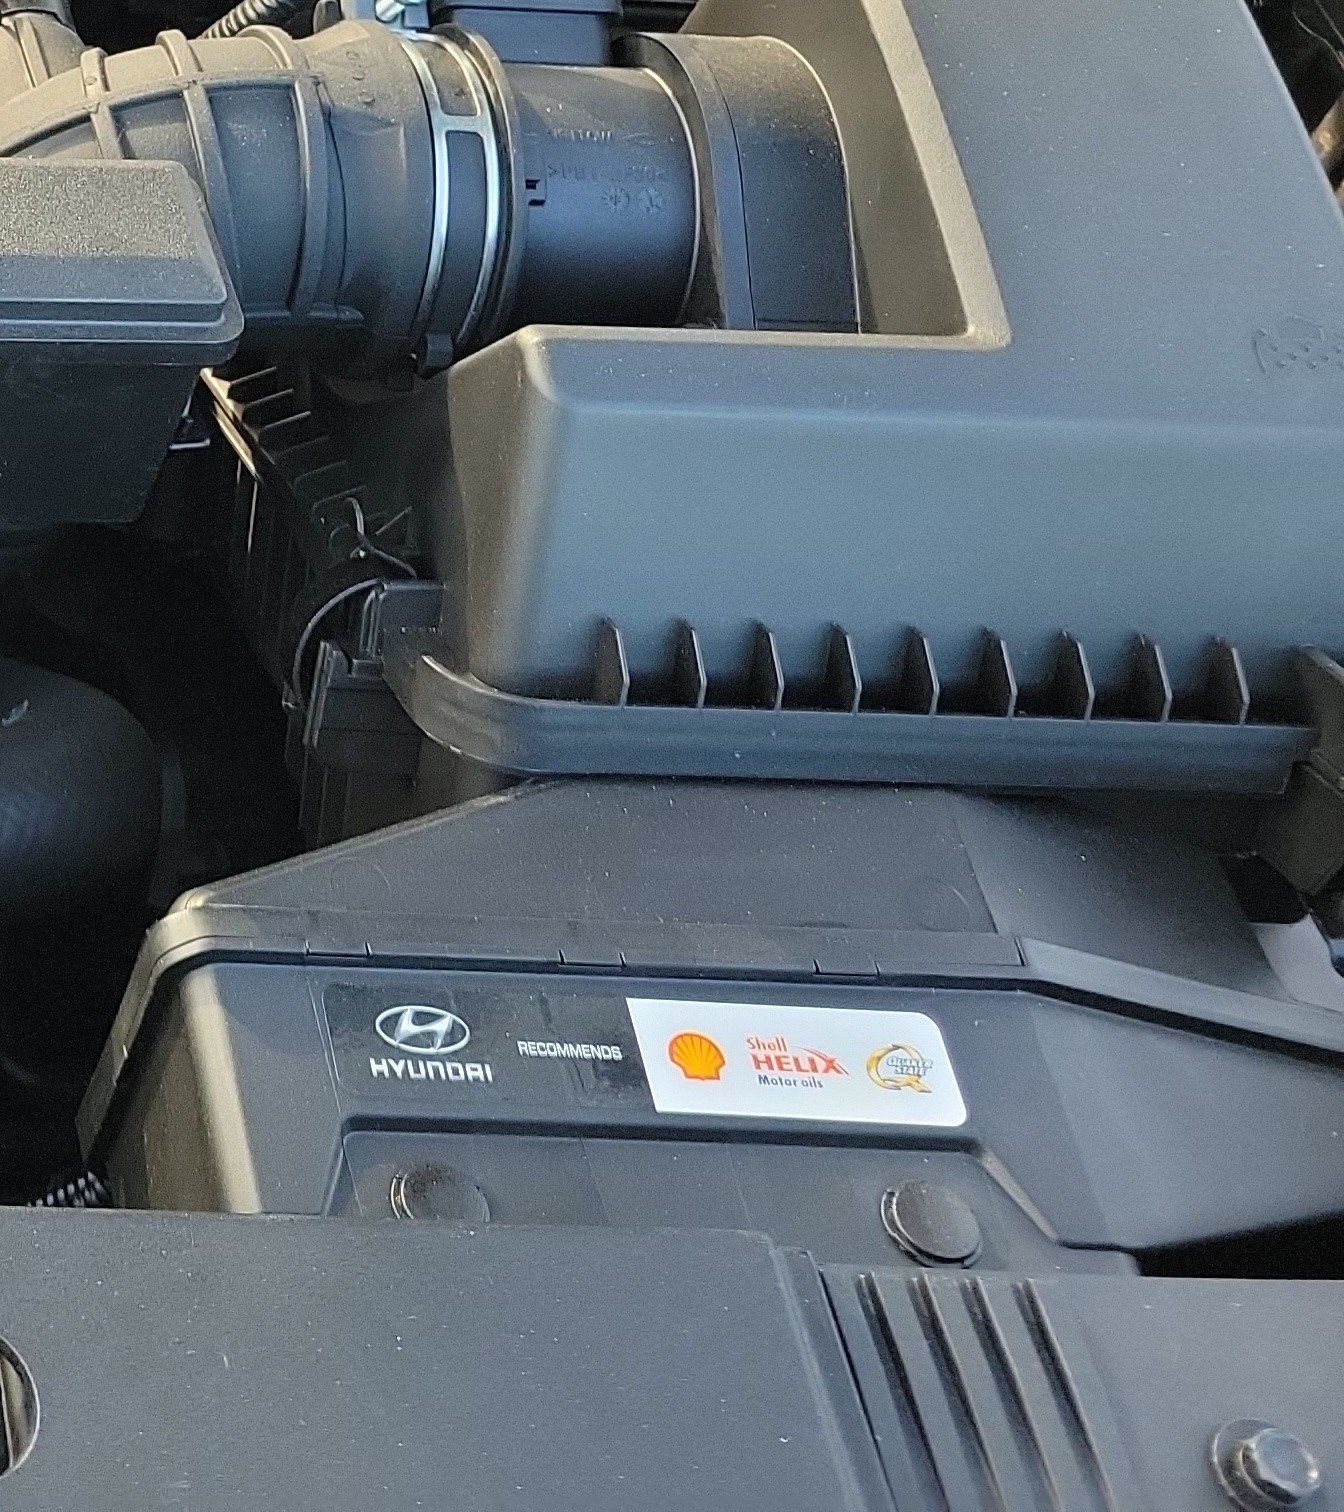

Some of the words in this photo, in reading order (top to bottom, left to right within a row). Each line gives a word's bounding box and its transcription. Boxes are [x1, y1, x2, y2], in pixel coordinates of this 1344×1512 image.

[746, 1036, 788, 1052] Shell
[370, 1057, 493, 1083] HYUNDAI
[517, 1040, 623, 1062] RECOMMENDS
[749, 1051, 846, 1076] HELIX
[758, 1075, 798, 1087] Motor
[802, 1076, 824, 1089] oils
